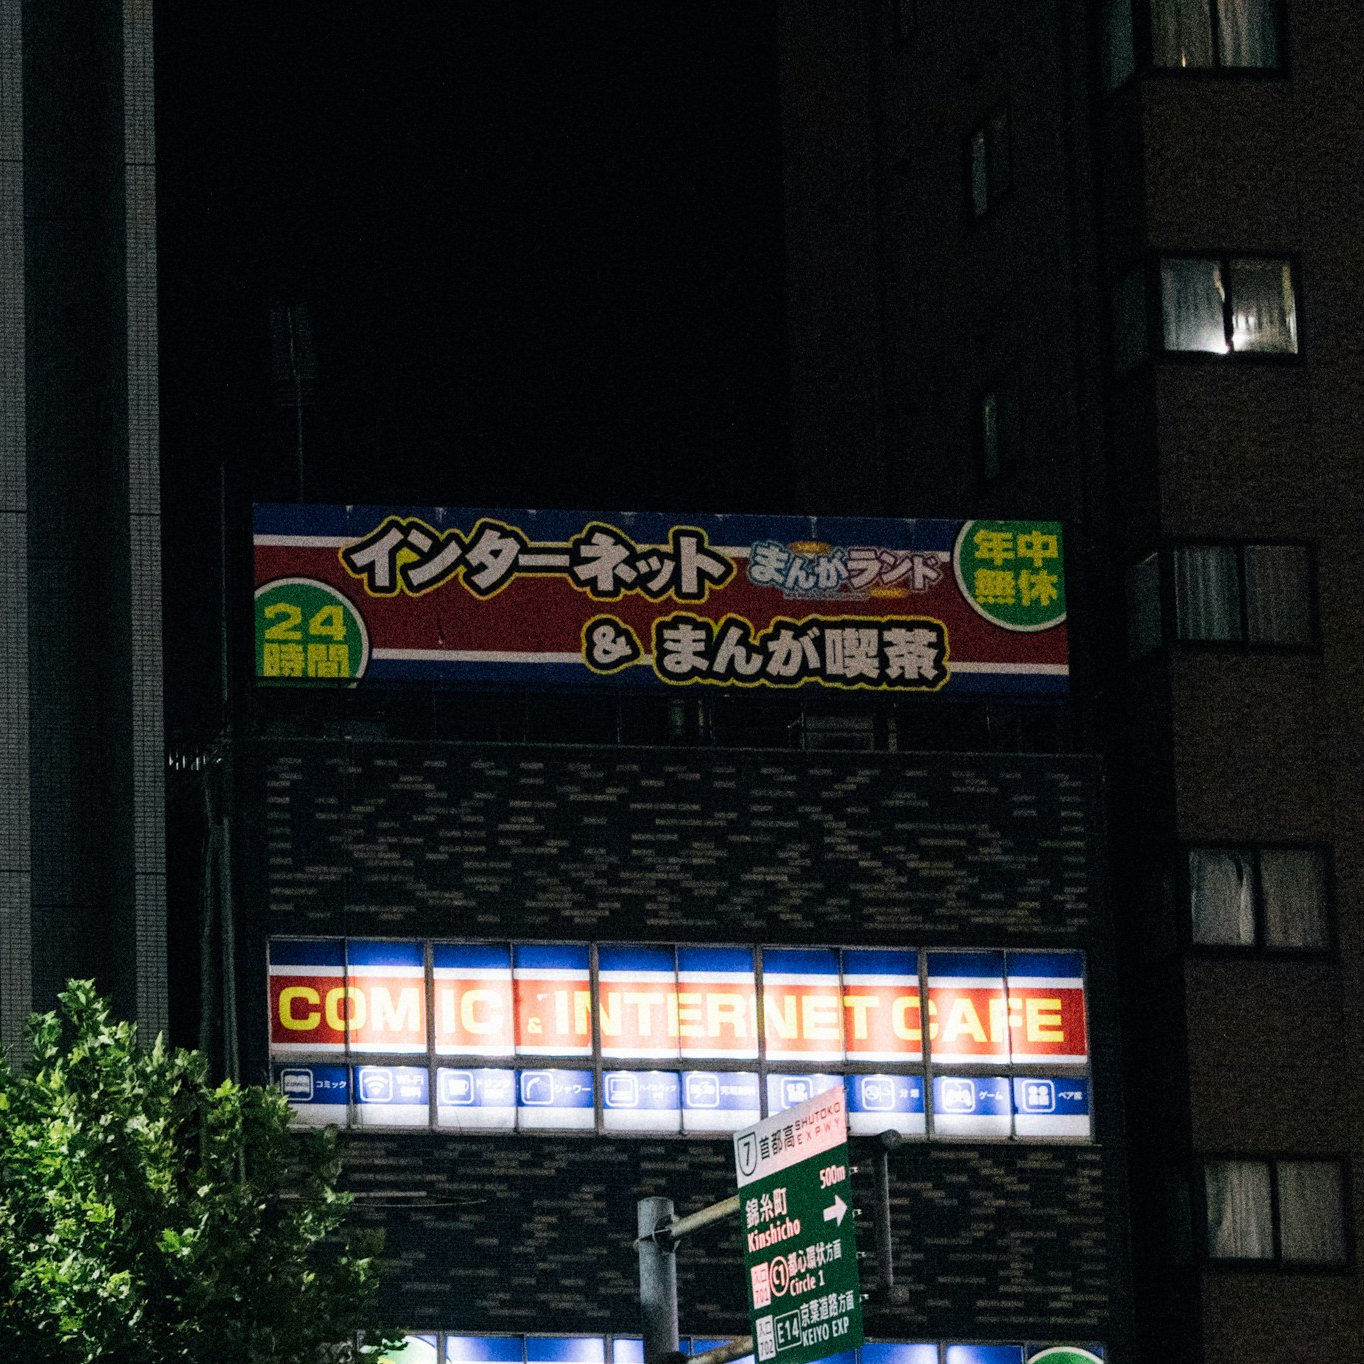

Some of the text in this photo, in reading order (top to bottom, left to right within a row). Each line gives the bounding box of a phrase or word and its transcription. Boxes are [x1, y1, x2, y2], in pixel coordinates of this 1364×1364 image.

[345, 521, 733, 598] インターネット
[974, 529, 1059, 564] 年中
[748, 541, 942, 591] まんがランド
[974, 572, 1059, 607] 無休
[263, 603, 348, 640] 24
[263, 641, 351, 677] 時間
[590, 619, 943, 684] & まんが喫茶
[278, 986, 504, 1034] COMIC
[556, 989, 884, 1041] INTERNET
[892, 995, 1066, 1044] CAFE
[315, 1080, 348, 1089] コミック
[554, 1084, 592, 1095] シャワー
[978, 1090, 1004, 1100] ゲーム
[795, 1101, 842, 1132] SHUTOKO
[742, 1141, 752, 1167] 7
[759, 1125, 796, 1160] 首都高
[819, 1164, 846, 1190] 500m
[745, 1187, 788, 1229] 錦糸町
[747, 1217, 802, 1253] Kinshicho
[772, 1264, 786, 1287] C1
[789, 1276, 817, 1299] Circle
[801, 1289, 855, 1328] 京葉道路方面
[777, 1320, 801, 1344] E14
[801, 1317, 850, 1347] KEIYO EXP
